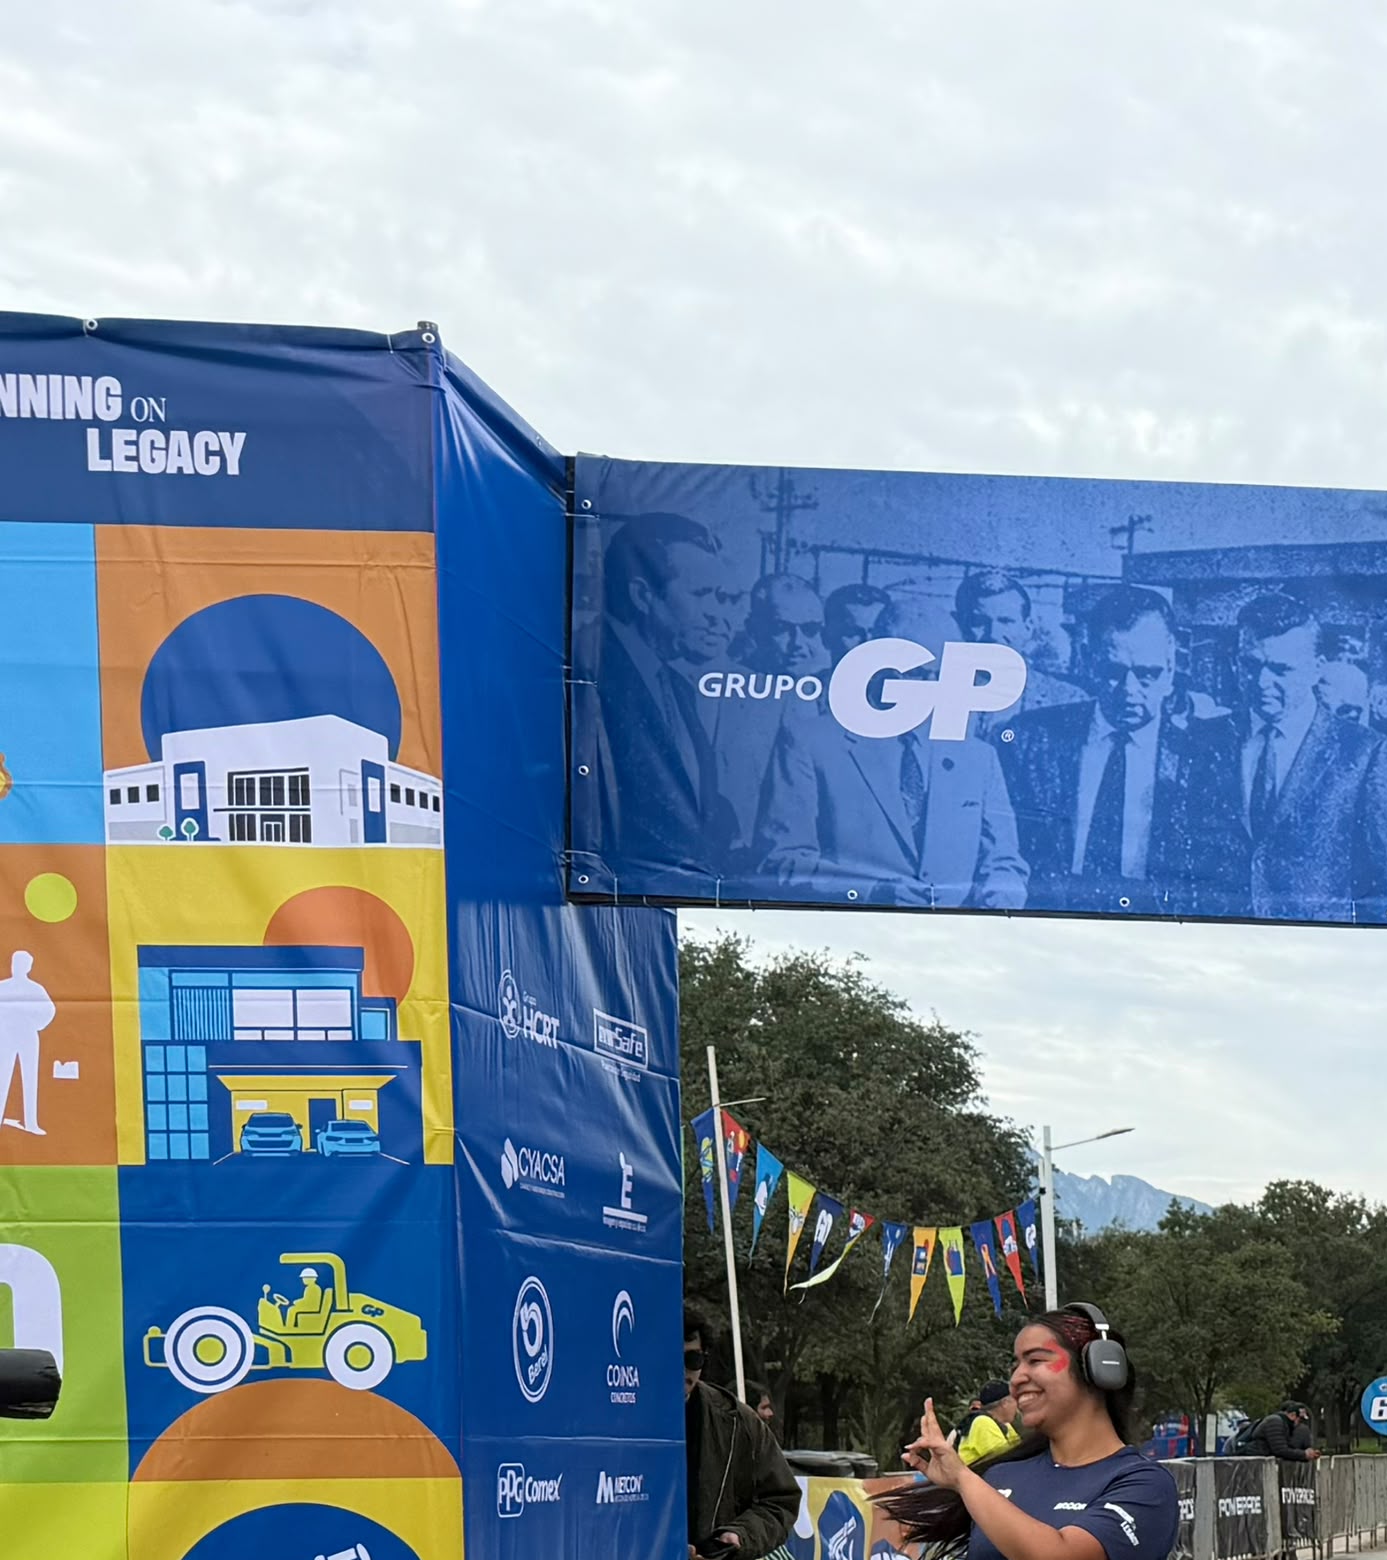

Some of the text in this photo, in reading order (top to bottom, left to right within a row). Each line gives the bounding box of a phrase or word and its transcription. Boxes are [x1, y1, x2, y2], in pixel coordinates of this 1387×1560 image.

[130, 396, 167, 422] ON
[87, 428, 247, 476] LEGACY
[698, 637, 1027, 741] GRUPO GP
[522, 1006, 560, 1048] HCRT
[518, 1146, 565, 1186] CYACSA
[361, 1302, 385, 1318] GP
[606, 1363, 640, 1387] COINSA
[525, 1472, 563, 1503] Comex
